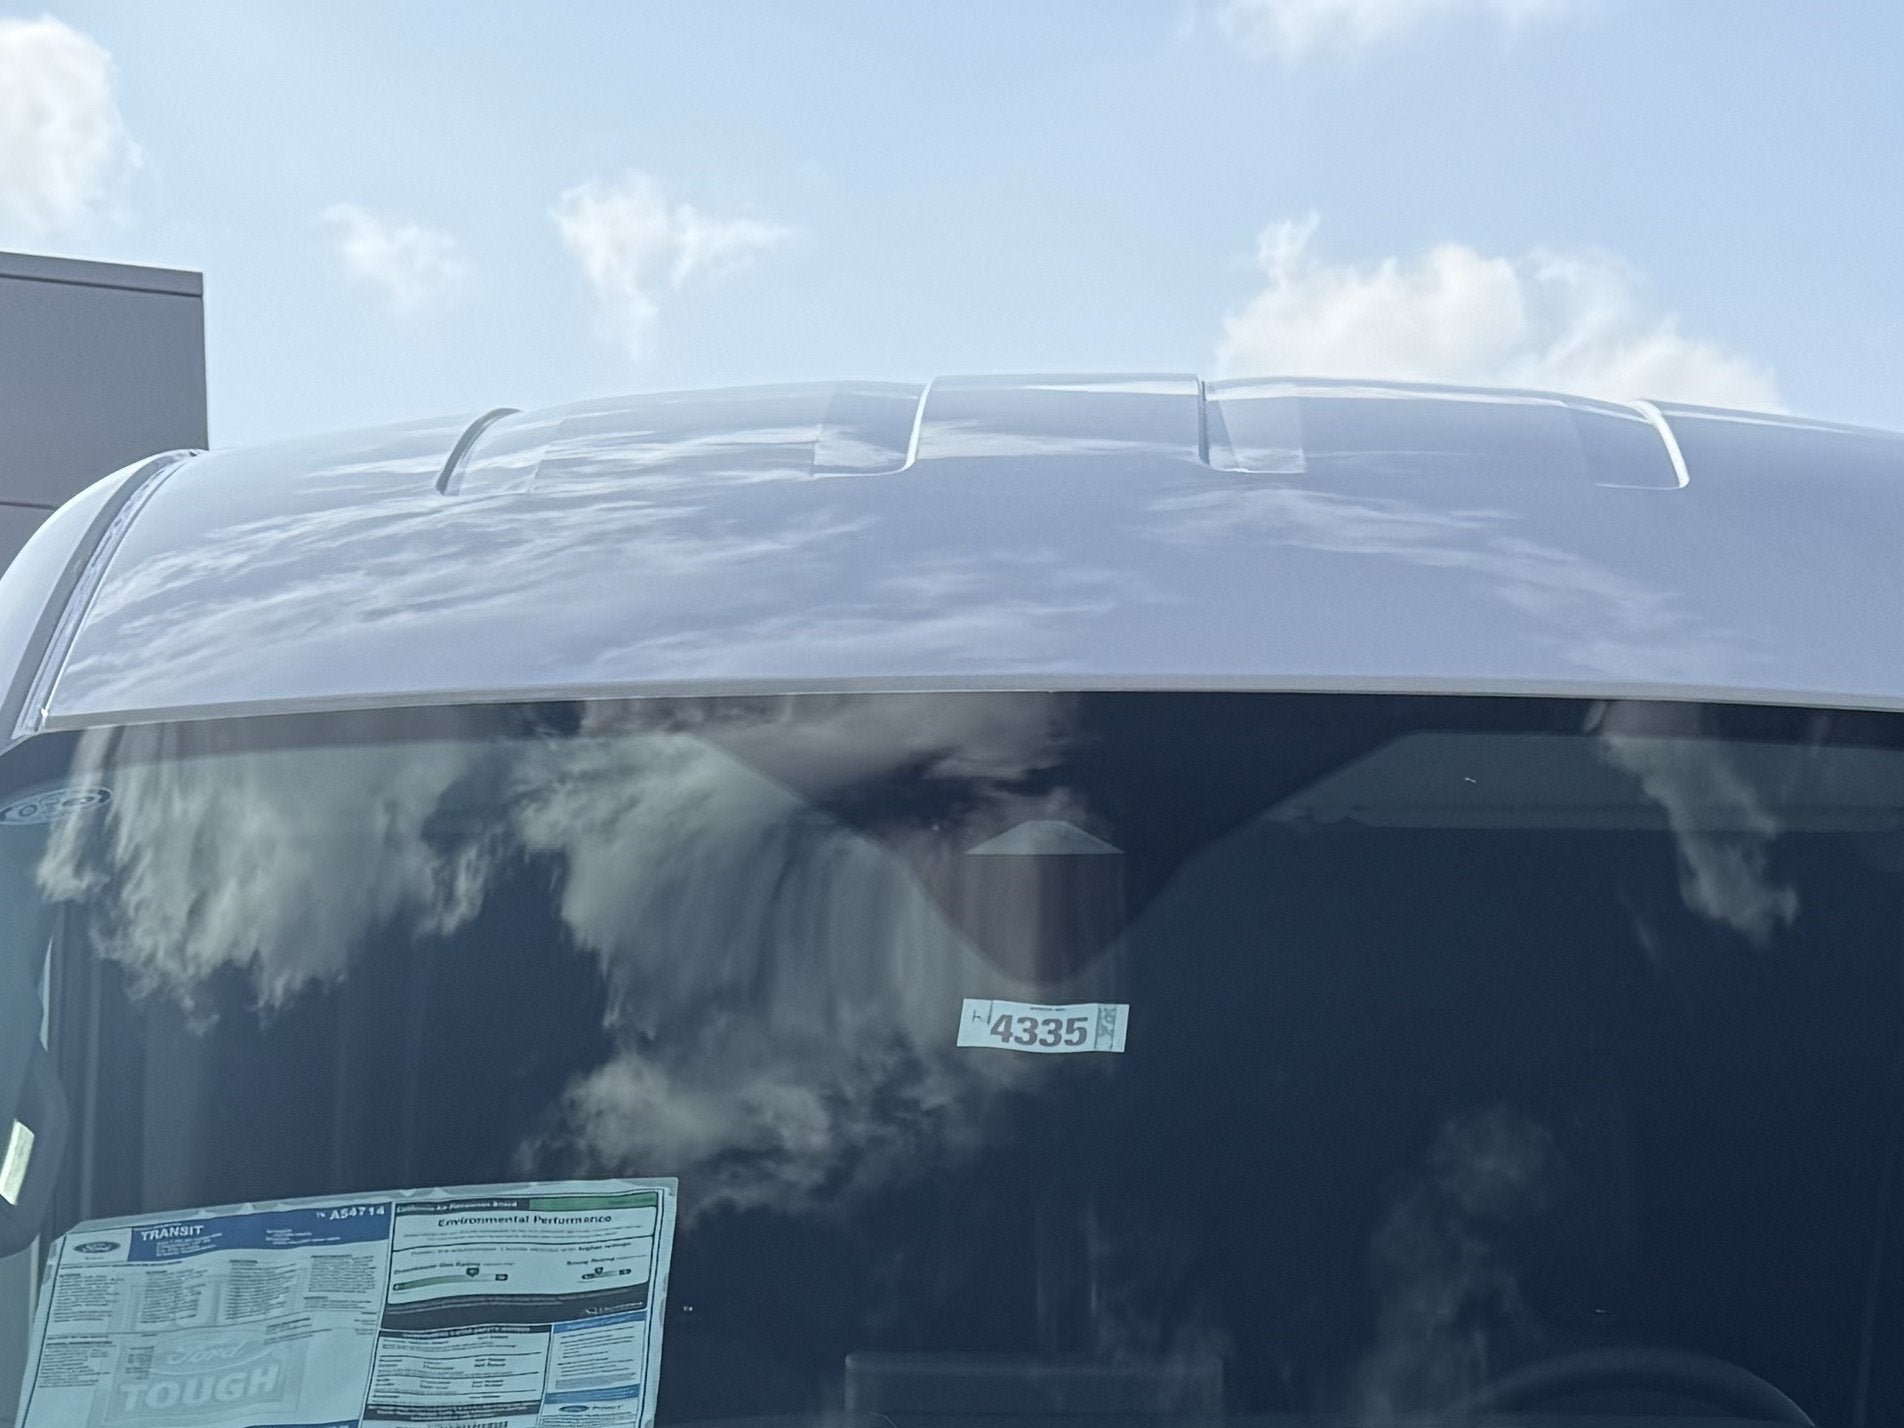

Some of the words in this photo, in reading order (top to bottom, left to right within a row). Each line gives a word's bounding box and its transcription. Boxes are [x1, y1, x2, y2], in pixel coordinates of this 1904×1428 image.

[990, 1014, 1089, 1047] 4335
[329, 1205, 386, 1221] A54714
[437, 1214, 530, 1228] Environmental
[533, 1213, 613, 1225] Performance
[140, 1224, 205, 1241] TRANSIT
[120, 1363, 281, 1413] TOUGH
